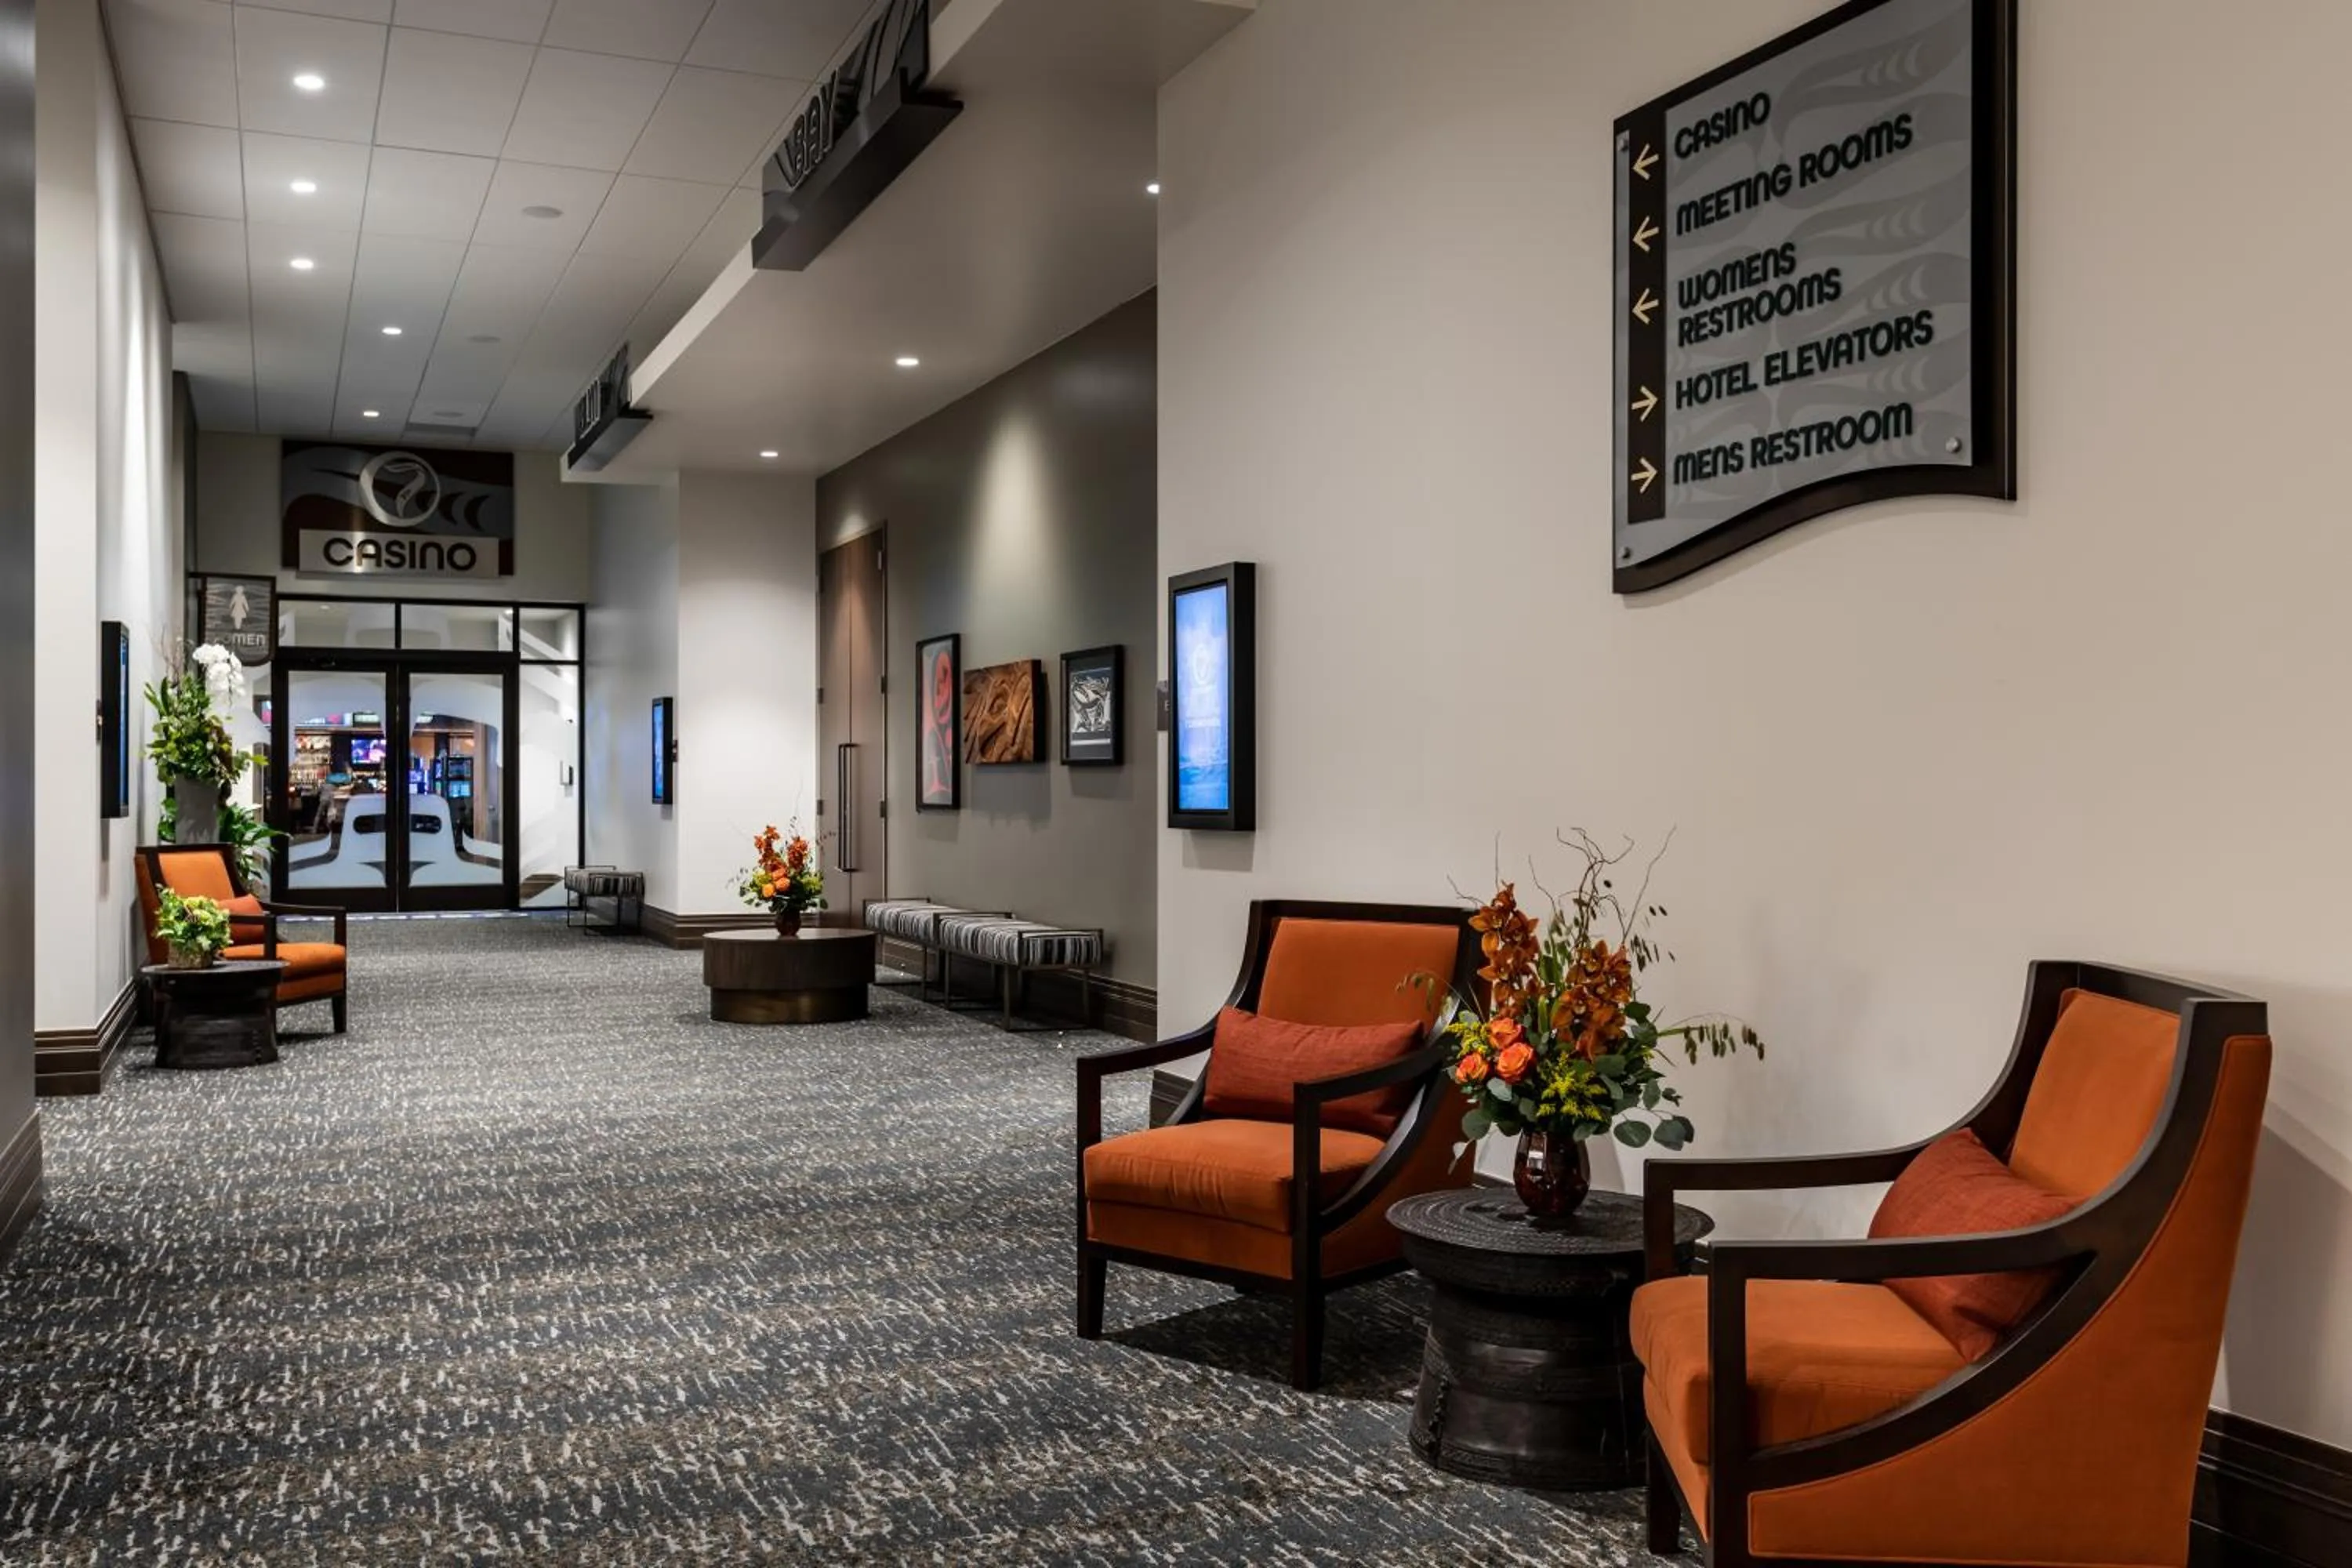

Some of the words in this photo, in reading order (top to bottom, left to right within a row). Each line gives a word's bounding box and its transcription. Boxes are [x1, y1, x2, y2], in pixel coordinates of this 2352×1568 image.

[1675, 91, 1771, 158] CASINO
[1676, 163, 1791, 235] MEETING
[1799, 113, 1913, 188] ROOMS
[1679, 242, 1796, 309] WOMENS
[1679, 267, 1842, 347] RESTROOMS
[1675, 361, 1757, 410] HOTEL
[1765, 310, 1933, 383] ELEVATORS
[1674, 441, 1744, 485] MENS
[1751, 401, 1913, 470] RESTROOM
[323, 539, 477, 571] CASINO
